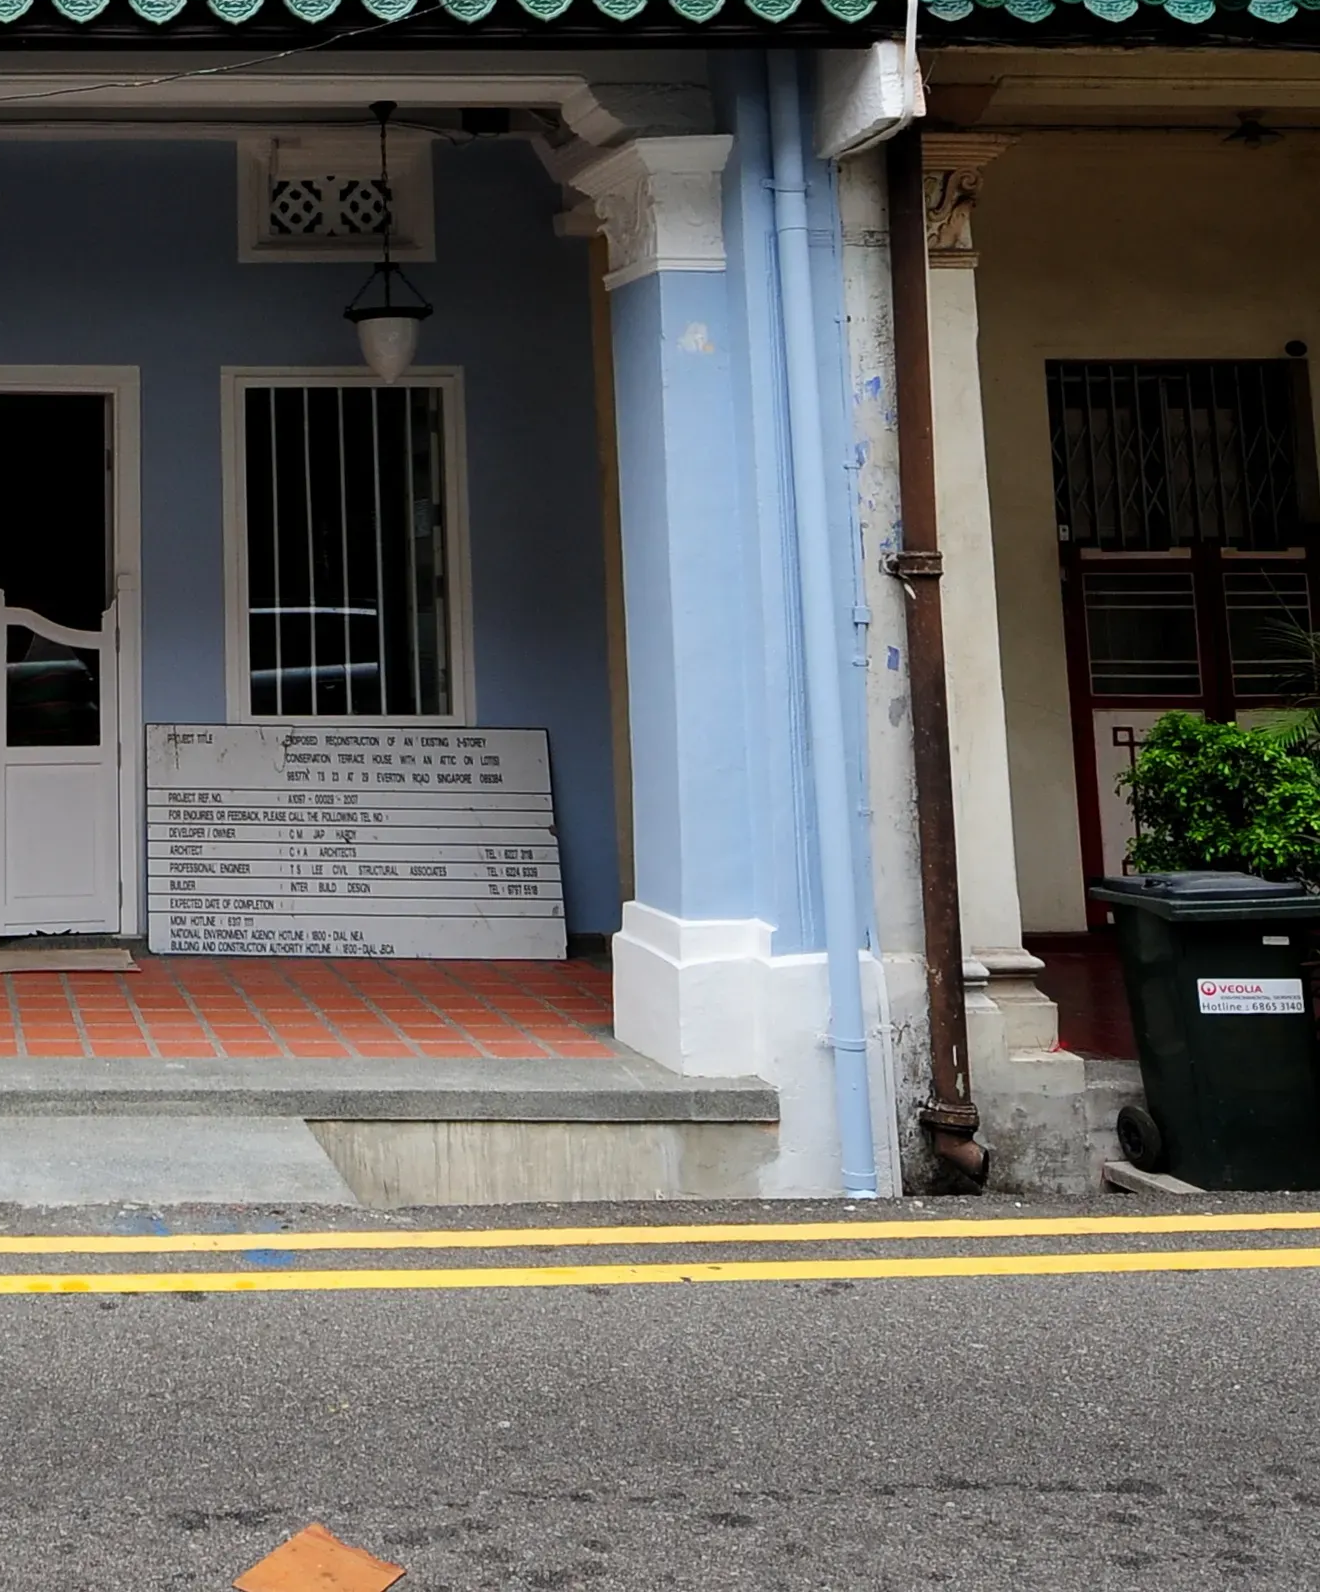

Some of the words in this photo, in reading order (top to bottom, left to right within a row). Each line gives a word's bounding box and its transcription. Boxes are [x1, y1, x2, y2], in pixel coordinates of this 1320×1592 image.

[197, 734, 213, 744] TITLE
[325, 736, 380, 746] RECONSTRUCTION
[387, 736, 396, 746] OF
[404, 737, 413, 746] AN
[421, 737, 449, 747] EXISTING
[456, 737, 486, 748] 2-STOREY
[285, 753, 331, 763] CONSERVATION
[337, 754, 365, 764] TERRACE
[372, 754, 392, 764] HOUSE
[400, 755, 416, 765] WITH
[423, 756, 432, 765] AN
[440, 756, 456, 765] ATTIC
[464, 756, 473, 766] ON
[347, 772, 354, 782] AT
[377, 773, 406, 783] EVERTON
[412, 773, 430, 784] ROAD
[437, 774, 472, 784] SINGAPORE
[168, 792, 195, 802] PROJECT
[168, 810, 180, 820] FOR
[216, 810, 225, 820] OR
[263, 811, 286, 822] PLEASE
[288, 812, 304, 822] CALL
[307, 812, 318, 822] THE
[321, 812, 358, 822] FOLLOWING
[360, 812, 371, 822] TEL
[373, 813, 382, 822] NO
[169, 827, 205, 838] DEVELOPER
[212, 828, 236, 838] OWNER
[170, 845, 202, 855] ARCHITECT
[320, 847, 356, 858] ARCHITECTS
[485, 848, 496, 859] TEL
[170, 862, 215, 873] PROFESSIONAL
[220, 864, 250, 874] ENGINEER
[312, 865, 322, 874] LEE
[358, 866, 399, 876] STRUCTURAL
[410, 866, 446, 876] ASSOCIATES
[487, 867, 498, 876] TEL
[170, 880, 196, 890] BUILDER
[290, 882, 308, 892] INTER
[319, 882, 336, 892] BUILD
[348, 883, 370, 893] DESIGN
[488, 884, 500, 894] TEL
[170, 898, 203, 909] EXPECTED
[205, 898, 220, 909] DATE
[222, 899, 231, 909] OF
[233, 899, 274, 910] COMPLETION
[170, 916, 186, 926] MOM
[190, 916, 216, 926] HOTLINE
[170, 928, 200, 939] NATIONAL
[204, 929, 248, 940] ENVIRONMENT
[251, 930, 276, 940] AGENCY
[279, 930, 304, 940] HOTLINE
[333, 931, 347, 941] DIAL
[350, 932, 364, 941] NEA
[171, 940, 200, 951] BUILDING
[202, 941, 216, 952] AND
[218, 942, 267, 952] CONSTRUCTION
[270, 943, 303, 953] AUTHORITY
[306, 943, 331, 954] HOTLINE
[1220, 984, 1263, 994] VEOLIA
[1202, 1002, 1242, 1012] Hotline
[1252, 1002, 1278, 1012] 6865
[1281, 1002, 1303, 1012] 3140
